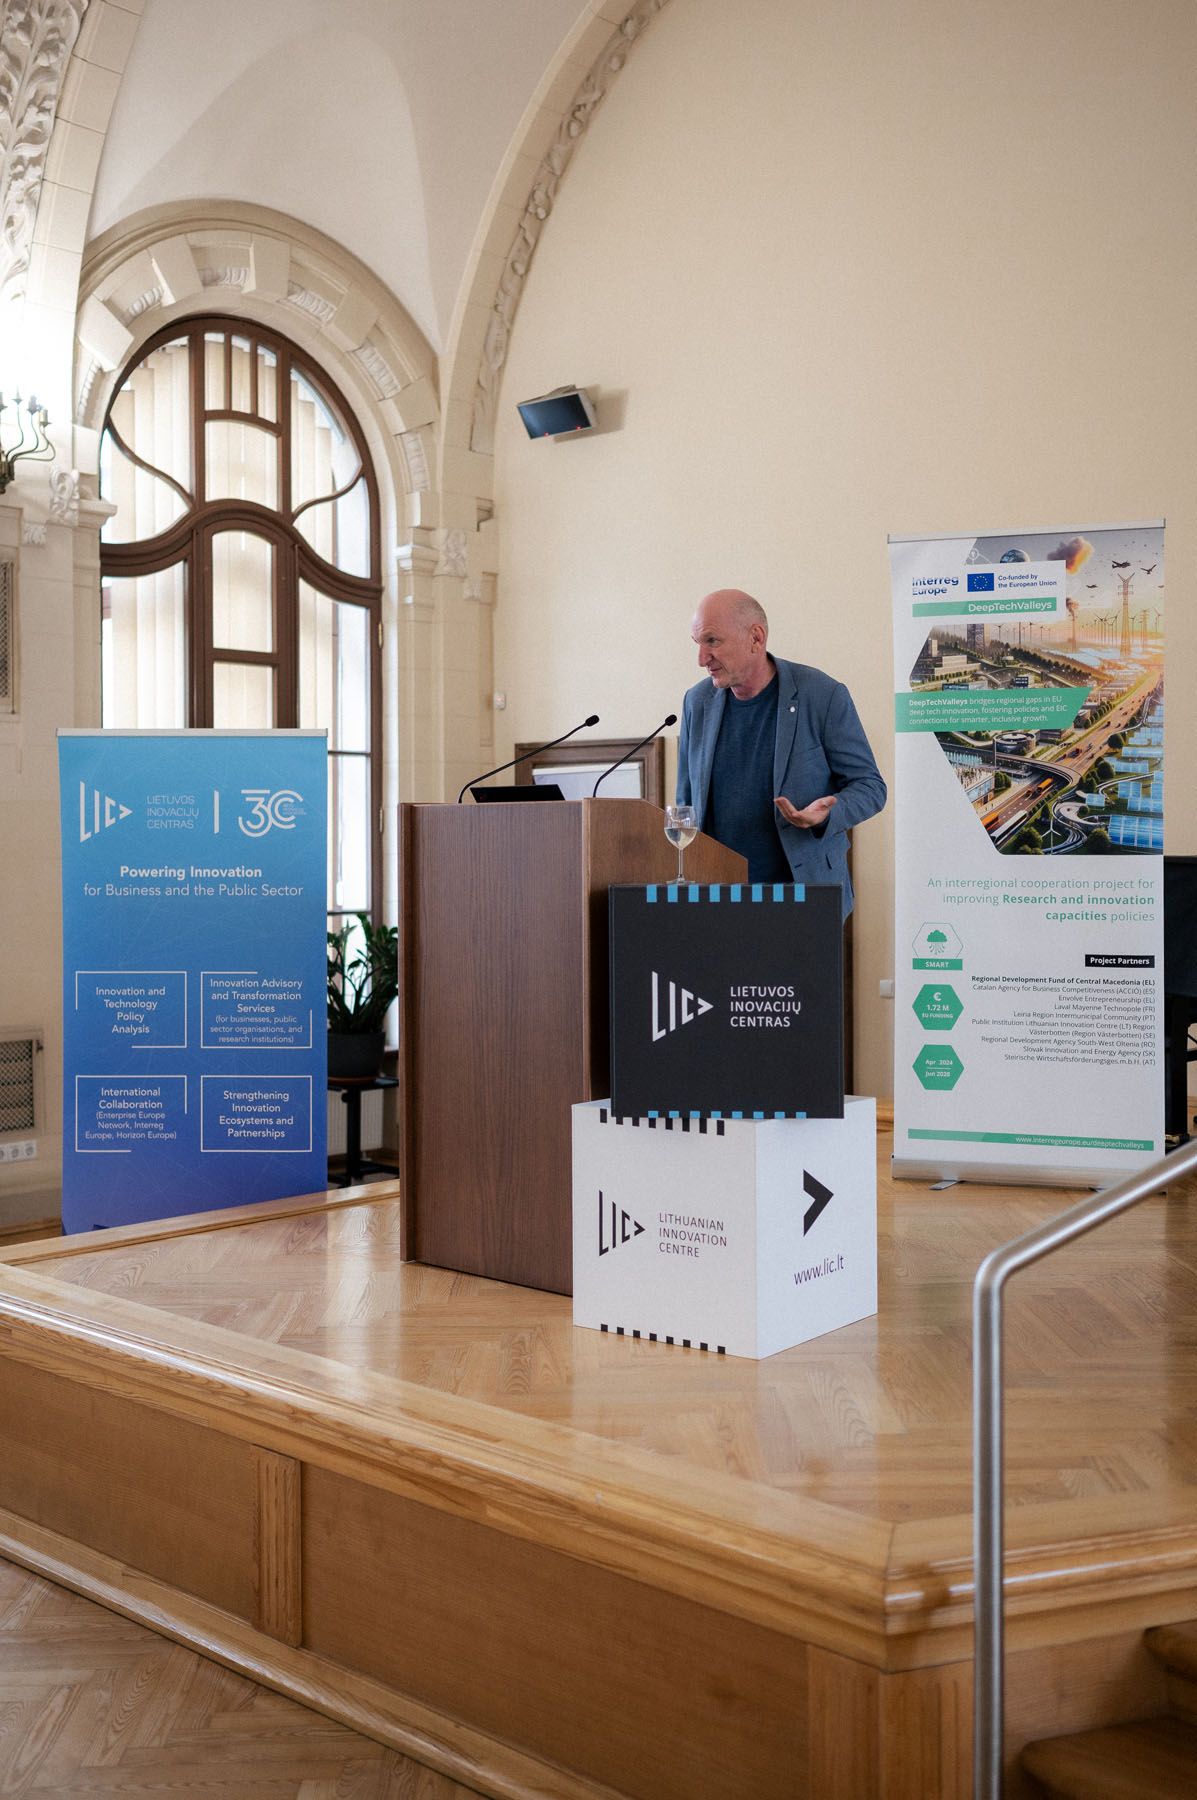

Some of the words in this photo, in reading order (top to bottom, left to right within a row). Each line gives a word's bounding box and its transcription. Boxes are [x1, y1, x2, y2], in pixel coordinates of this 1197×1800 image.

[912, 576, 959, 587] Interreg
[912, 587, 947, 596] Europe
[968, 601, 1052, 613] DeepTechValleys
[909, 698, 968, 707] DeepTechValleys
[969, 698, 995, 706] bridges
[997, 697, 1024, 705] regional
[909, 708, 925, 716] deep
[982, 706, 1012, 714] fostering
[147, 796, 195, 805] LIETUVOS
[147, 820, 194, 829] CENTRAS
[120, 866, 185, 880] Powering
[191, 866, 262, 877] Innovation
[84, 884, 102, 896] for
[106, 884, 161, 896] Business
[165, 884, 190, 896] and
[193, 884, 215, 896] the
[219, 884, 257, 896] Public
[262, 884, 303, 896] Sector
[927, 878, 942, 888] An
[945, 878, 1017, 891] interregional
[1021, 879, 1089, 891] cooperation
[1093, 879, 1134, 891] project
[1137, 879, 1154, 889] for
[943, 894, 999, 906] improving
[1003, 894, 1057, 904] Research
[1061, 895, 1083, 904] and
[1087, 895, 1154, 905] innovation
[1046, 911, 1107, 923] capacities
[1111, 912, 1155, 924] policies
[1090, 957, 1116, 966] Project
[1118, 957, 1149, 965] Partners
[210, 979, 259, 988] Innovation
[262, 979, 302, 991] Advisory
[96, 987, 145, 996] Innovation
[148, 987, 166, 996] and
[211, 991, 229, 1000] and
[232, 991, 301, 1000] Transformation
[730, 985, 795, 997] LIETUVOS
[104, 999, 157, 1010] Technology
[237, 1004, 275, 1013] Services
[730, 1001, 801, 1015] INOVACIJŲ
[117, 1012, 144, 1023] Policy
[216, 1015, 228, 1023] (for
[230, 1015, 272, 1024] businesses,
[274, 1015, 296, 1025] public
[730, 1015, 791, 1028] CENTRAS
[112, 1024, 150, 1036] Analysis
[235, 1025, 284, 1035] organisations,
[287, 1025, 302, 1033] and
[219, 1035, 249, 1043] research
[252, 1035, 294, 1044] institutions)
[101, 1087, 161, 1096] International
[224, 1090, 289, 1102] Strengthening
[99, 1100, 162, 1109] Collaboration
[232, 1103, 281, 1112] Innovation
[96, 1111, 136, 1121] (Enterprise
[138, 1112, 166, 1121] Europe
[219, 1116, 273, 1127] Ecosystems
[276, 1116, 294, 1125] and
[98, 1122, 132, 1130] Network,
[134, 1122, 164, 1131] Interreg
[85, 1132, 114, 1141] Europe,
[148, 1132, 176, 1141] Europe)
[228, 1129, 285, 1139] Partnerships
[658, 1212, 724, 1231] LITHUANIAN
[658, 1227, 728, 1247] INNOVATION
[658, 1242, 700, 1258] CENTRE
[794, 1254, 844, 1286] www.lic.lt
